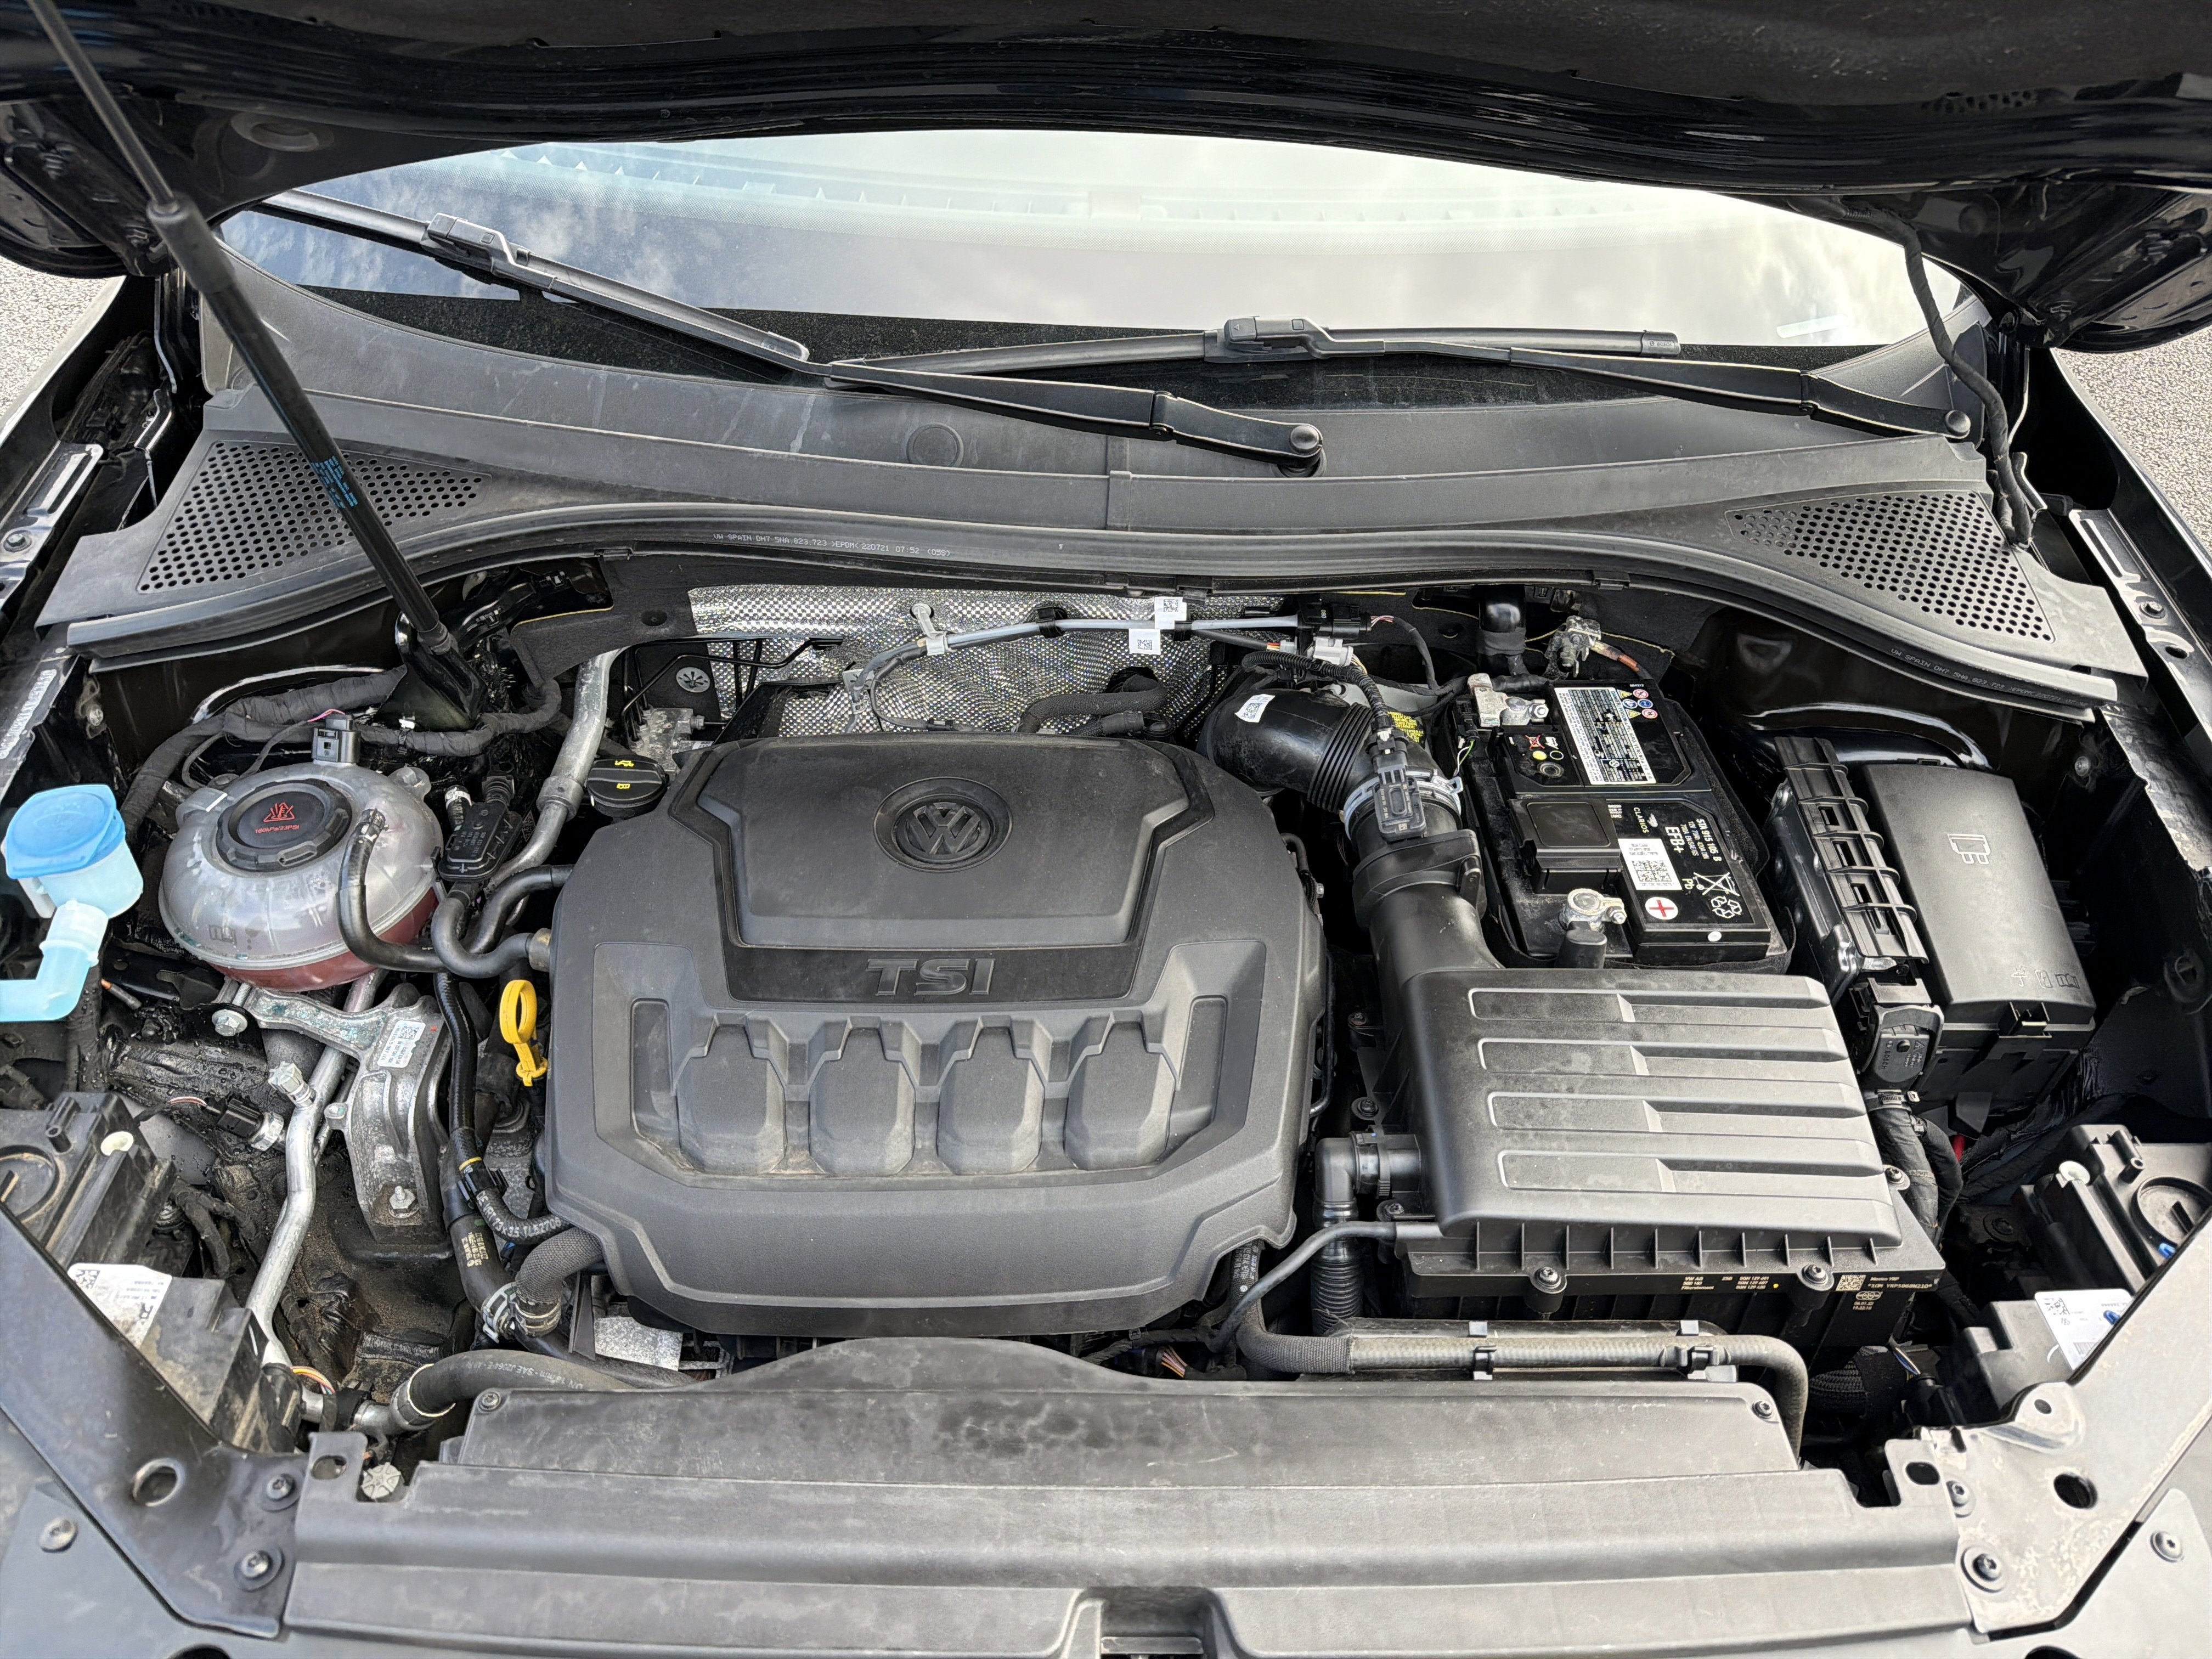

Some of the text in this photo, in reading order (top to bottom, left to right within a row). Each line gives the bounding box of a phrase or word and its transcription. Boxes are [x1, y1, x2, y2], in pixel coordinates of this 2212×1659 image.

[861, 543, 889, 552] 220721
[895, 546, 919, 554] 07:52
[1891, 648, 1902, 657] VW
[1905, 654, 1931, 668] SPAIN
[1633, 807, 1650, 833] CLARIOS
[1664, 827, 1685, 854] EFB+
[1701, 831, 1713, 842] 915
[1707, 843, 1719, 855] 105
[1681, 878, 1695, 890] Pb
[866, 958, 996, 996] TSI
[516, 1365, 534, 1376] SAE
